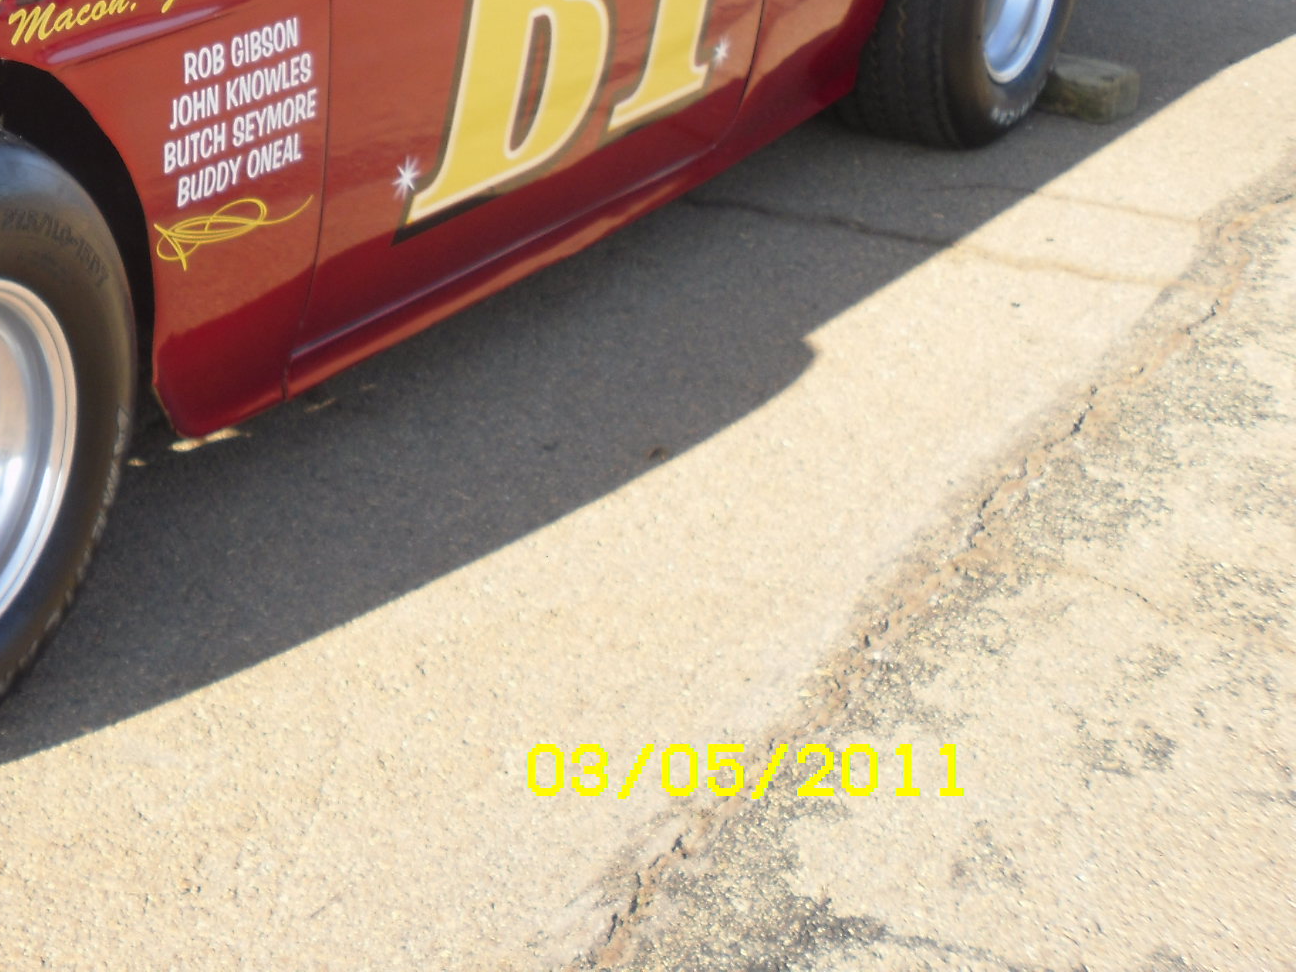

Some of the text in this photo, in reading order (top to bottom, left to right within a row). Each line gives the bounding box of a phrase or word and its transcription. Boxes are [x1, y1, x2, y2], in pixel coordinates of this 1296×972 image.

[183, 17, 299, 85] ROB GIBSON
[169, 53, 312, 130] JOHN KNOWLES
[163, 88, 317, 174] BUTCH SEYMORE
[176, 133, 302, 208] BUDDY ONEAL
